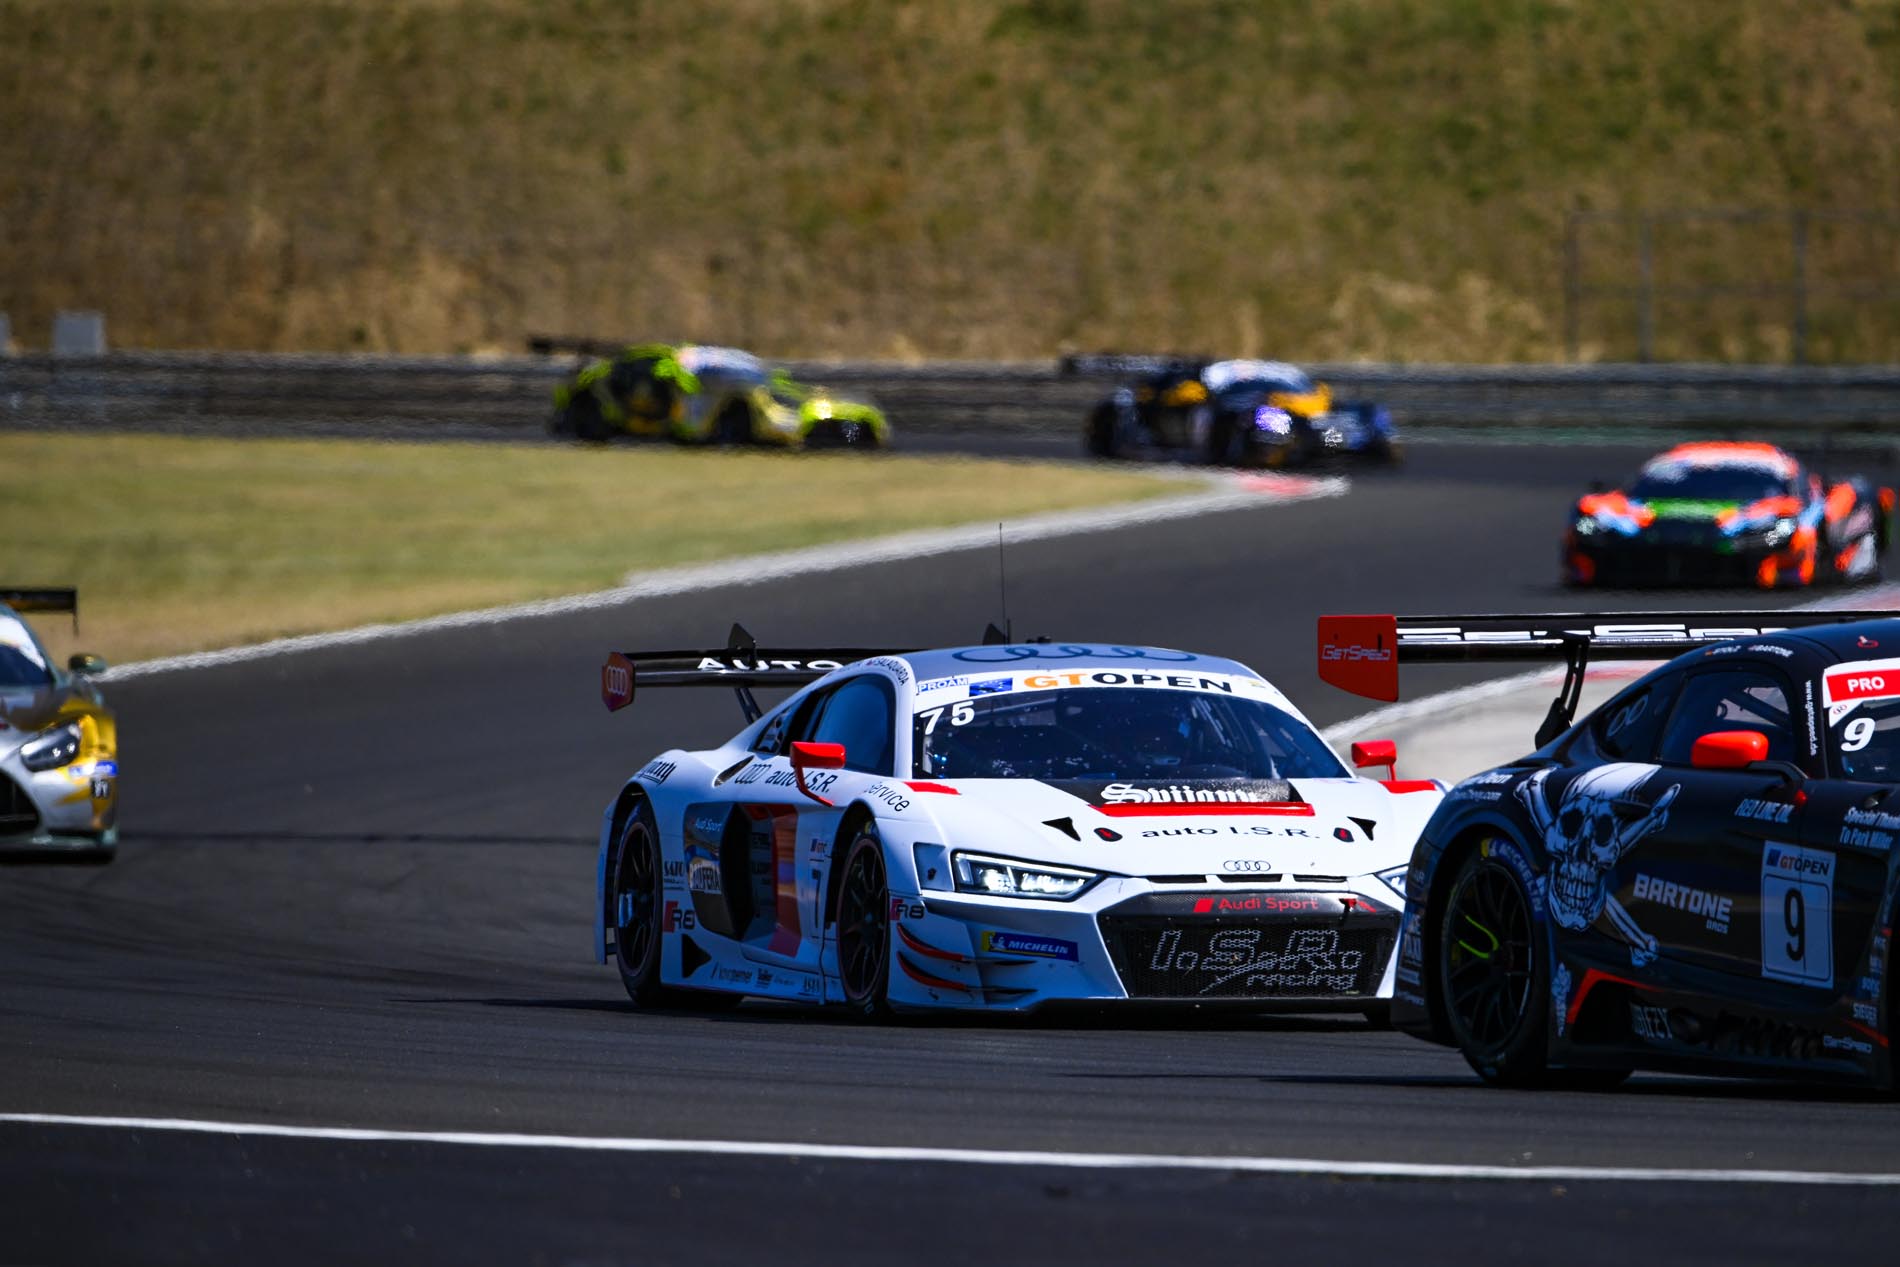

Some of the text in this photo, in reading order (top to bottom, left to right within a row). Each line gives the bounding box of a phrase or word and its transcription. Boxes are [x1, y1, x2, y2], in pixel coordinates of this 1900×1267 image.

[697, 657, 844, 671] AUTO
[918, 677, 969, 693] PROAM
[1847, 676, 1885, 693] PRO
[919, 700, 976, 735] 75
[1840, 717, 1876, 752] 9
[765, 770, 838, 793] auto IS.R.
[1142, 826, 1218, 838] auto
[1218, 897, 1319, 912] Audi Sport
[1633, 872, 1733, 923] BARTONE
[672, 909, 695, 930] R8
[895, 903, 925, 919] R8
[1784, 887, 1806, 962] 9
[1008, 940, 1069, 954] MICHELIN
